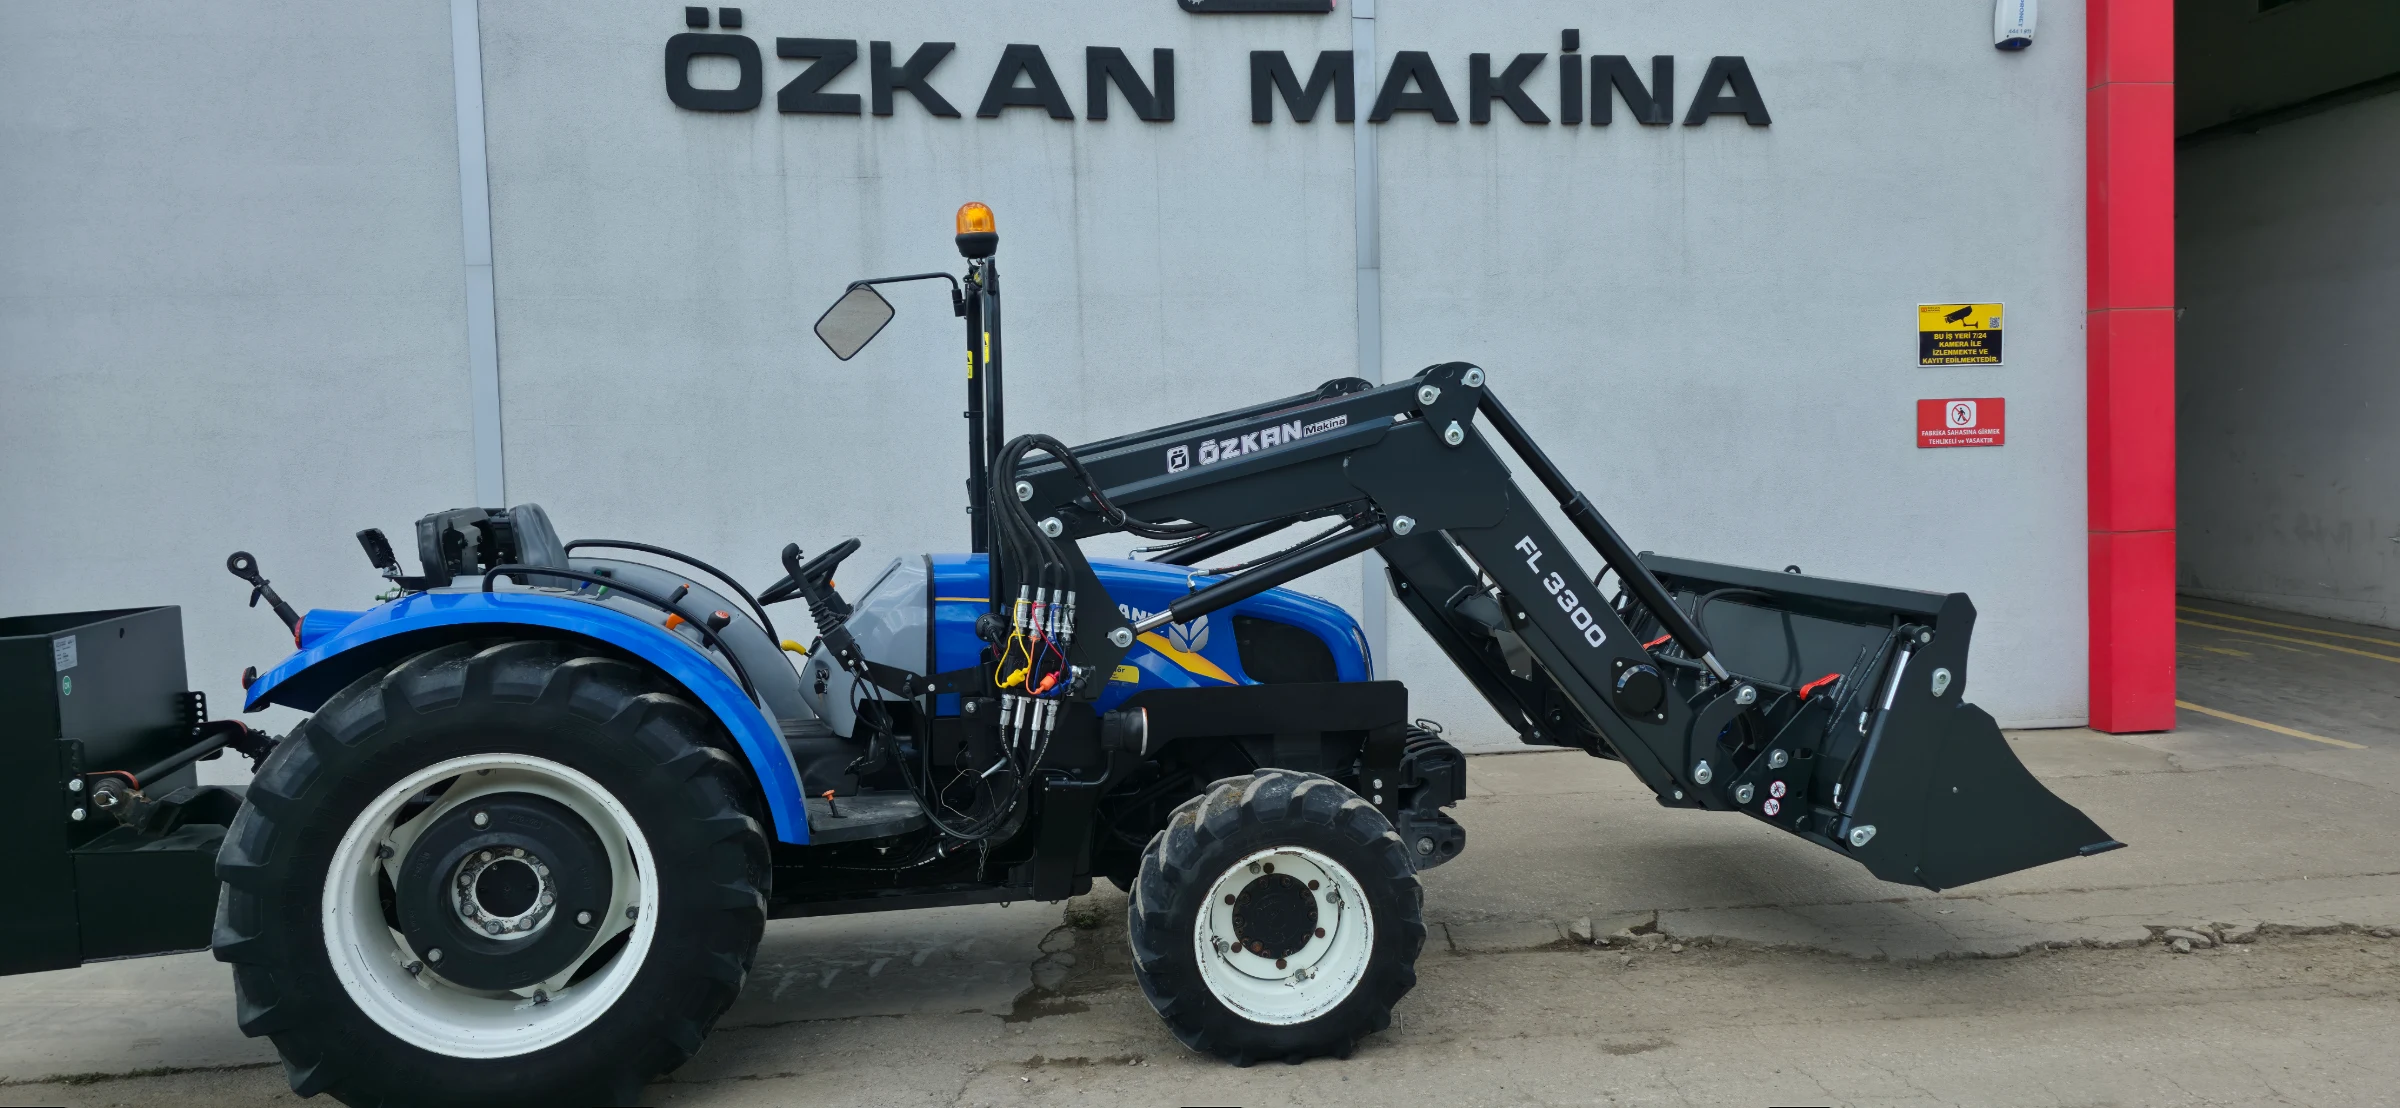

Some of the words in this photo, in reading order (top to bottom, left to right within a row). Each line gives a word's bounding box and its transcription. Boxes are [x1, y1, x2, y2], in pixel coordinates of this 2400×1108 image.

[664, 6, 1176, 122] ÖZKAN
[1250, 29, 1773, 127] MAKİNA
[1946, 332, 1953, 340] İŞ
[1939, 340, 1969, 348] KAMERA
[1971, 339, 1982, 347] İLE
[1932, 348, 1977, 356] İZLENMEKTE
[1946, 355, 1999, 364] EDİLMEKTEDİR.
[1921, 429, 1946, 437] FABRİKA
[1199, 420, 1302, 466] ÖZKAN
[1305, 417, 1346, 436] Makina
[1929, 437, 1957, 445] TEHLİKELİ
[1514, 535, 1542, 574] FL
[1543, 571, 1607, 648] 3300
